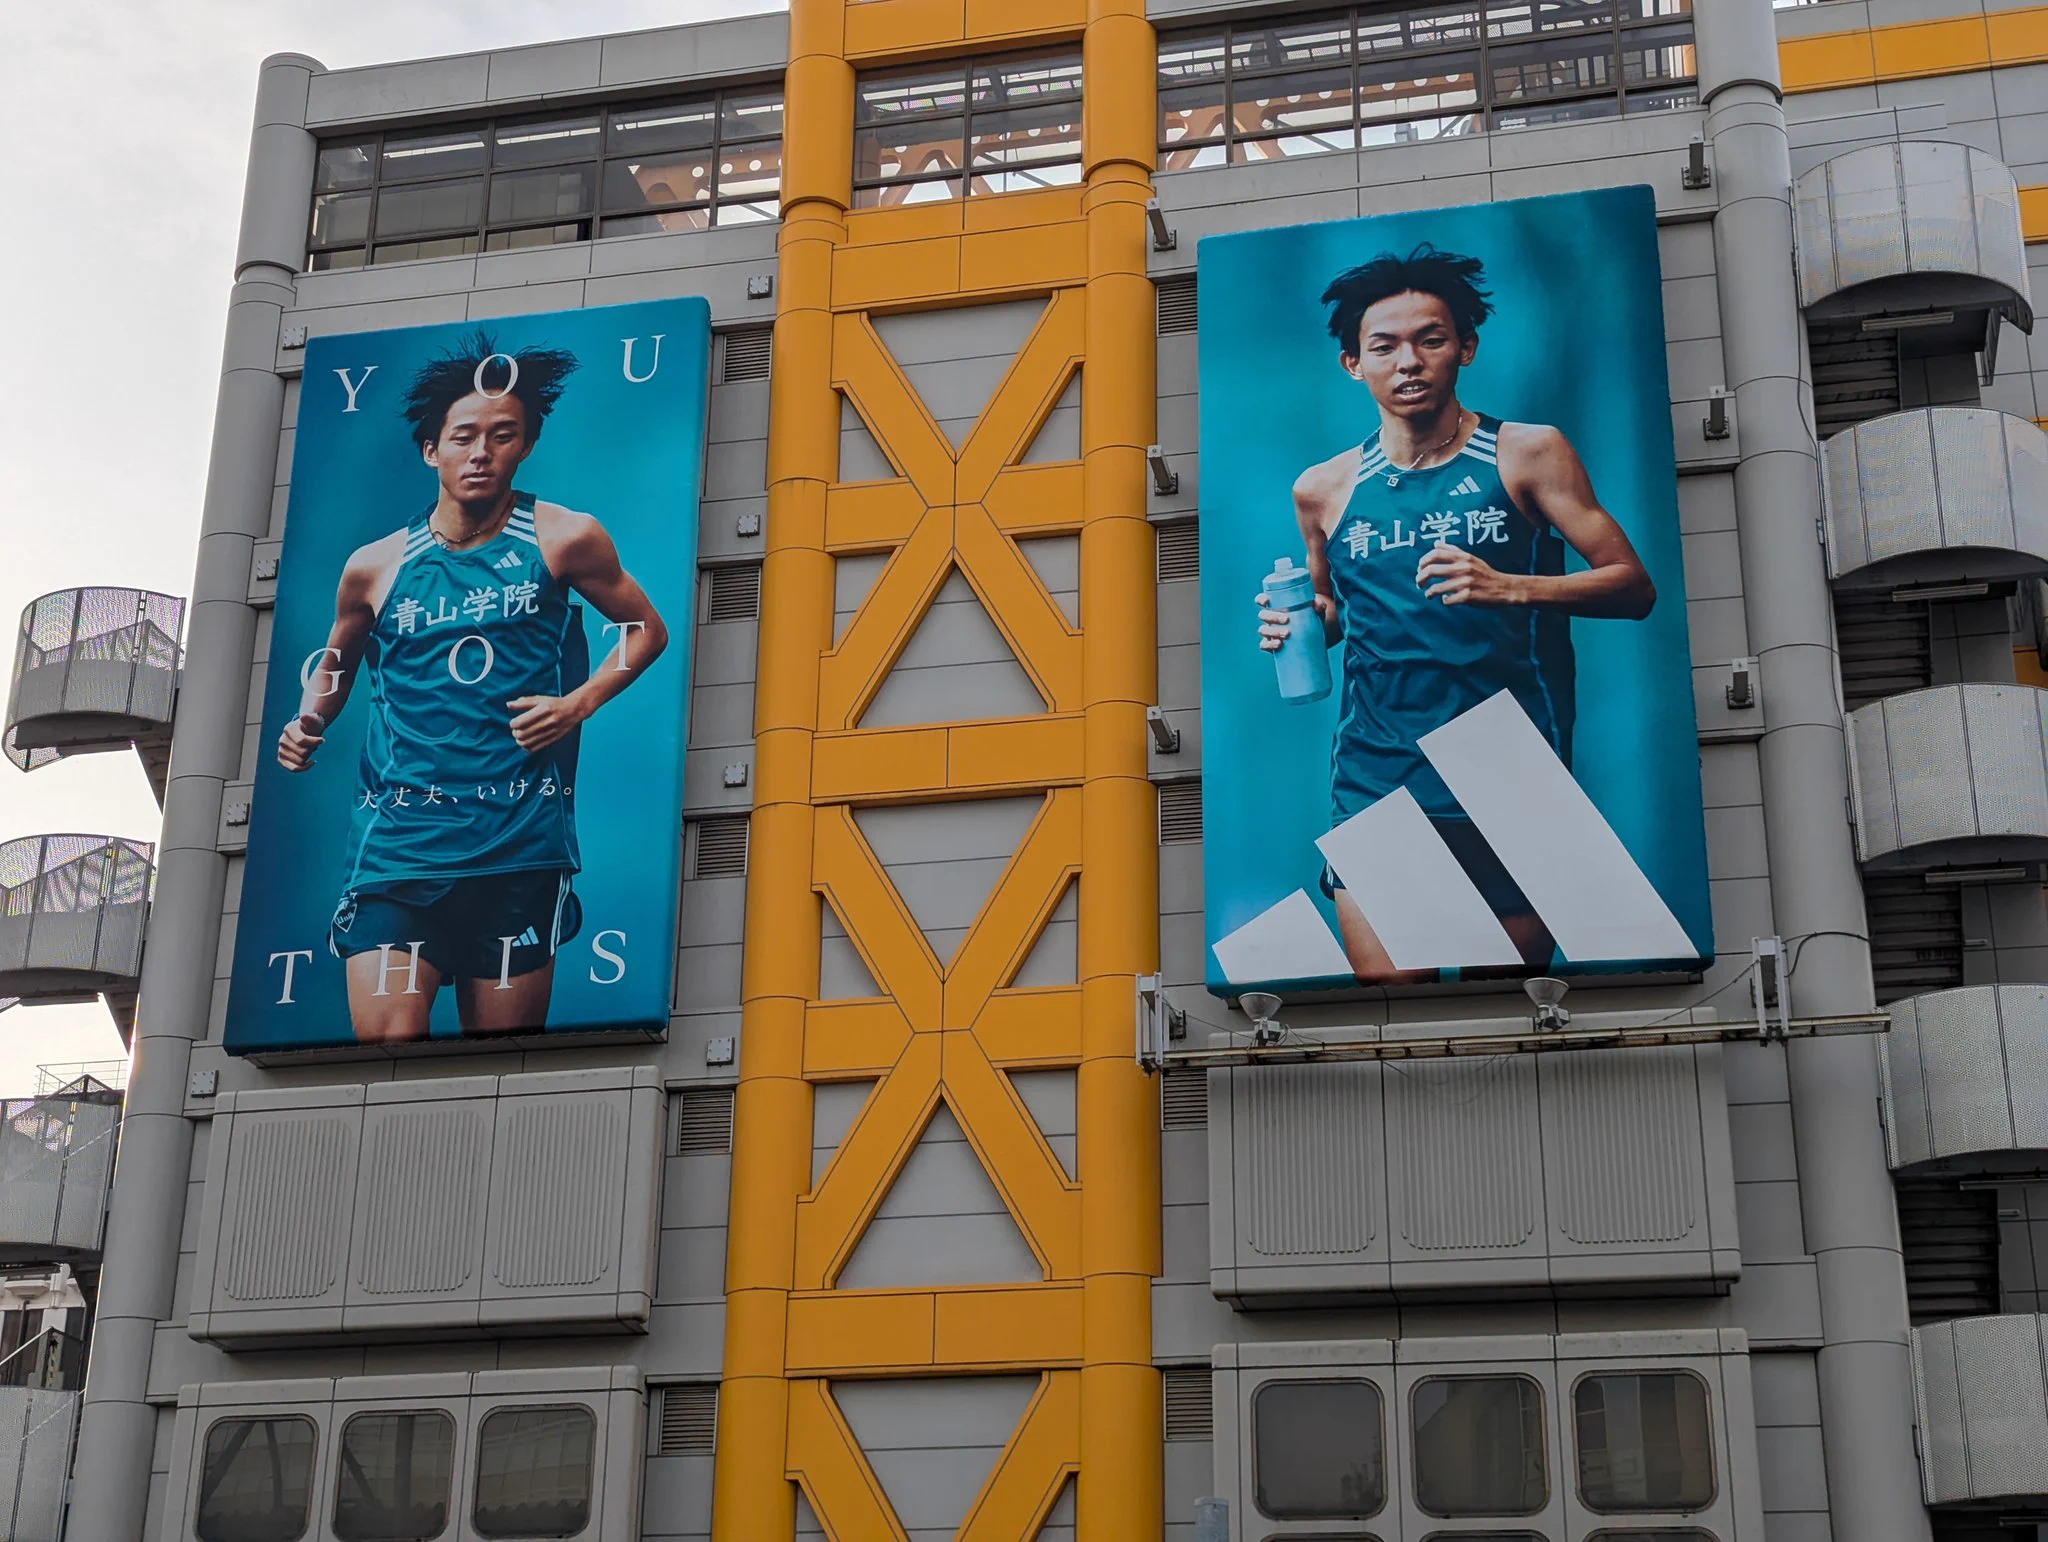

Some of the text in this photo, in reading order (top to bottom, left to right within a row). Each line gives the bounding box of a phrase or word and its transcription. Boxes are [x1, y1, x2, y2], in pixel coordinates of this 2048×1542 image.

[1342, 506, 1509, 560] 青山学院
[391, 580, 539, 635] 青山学院
